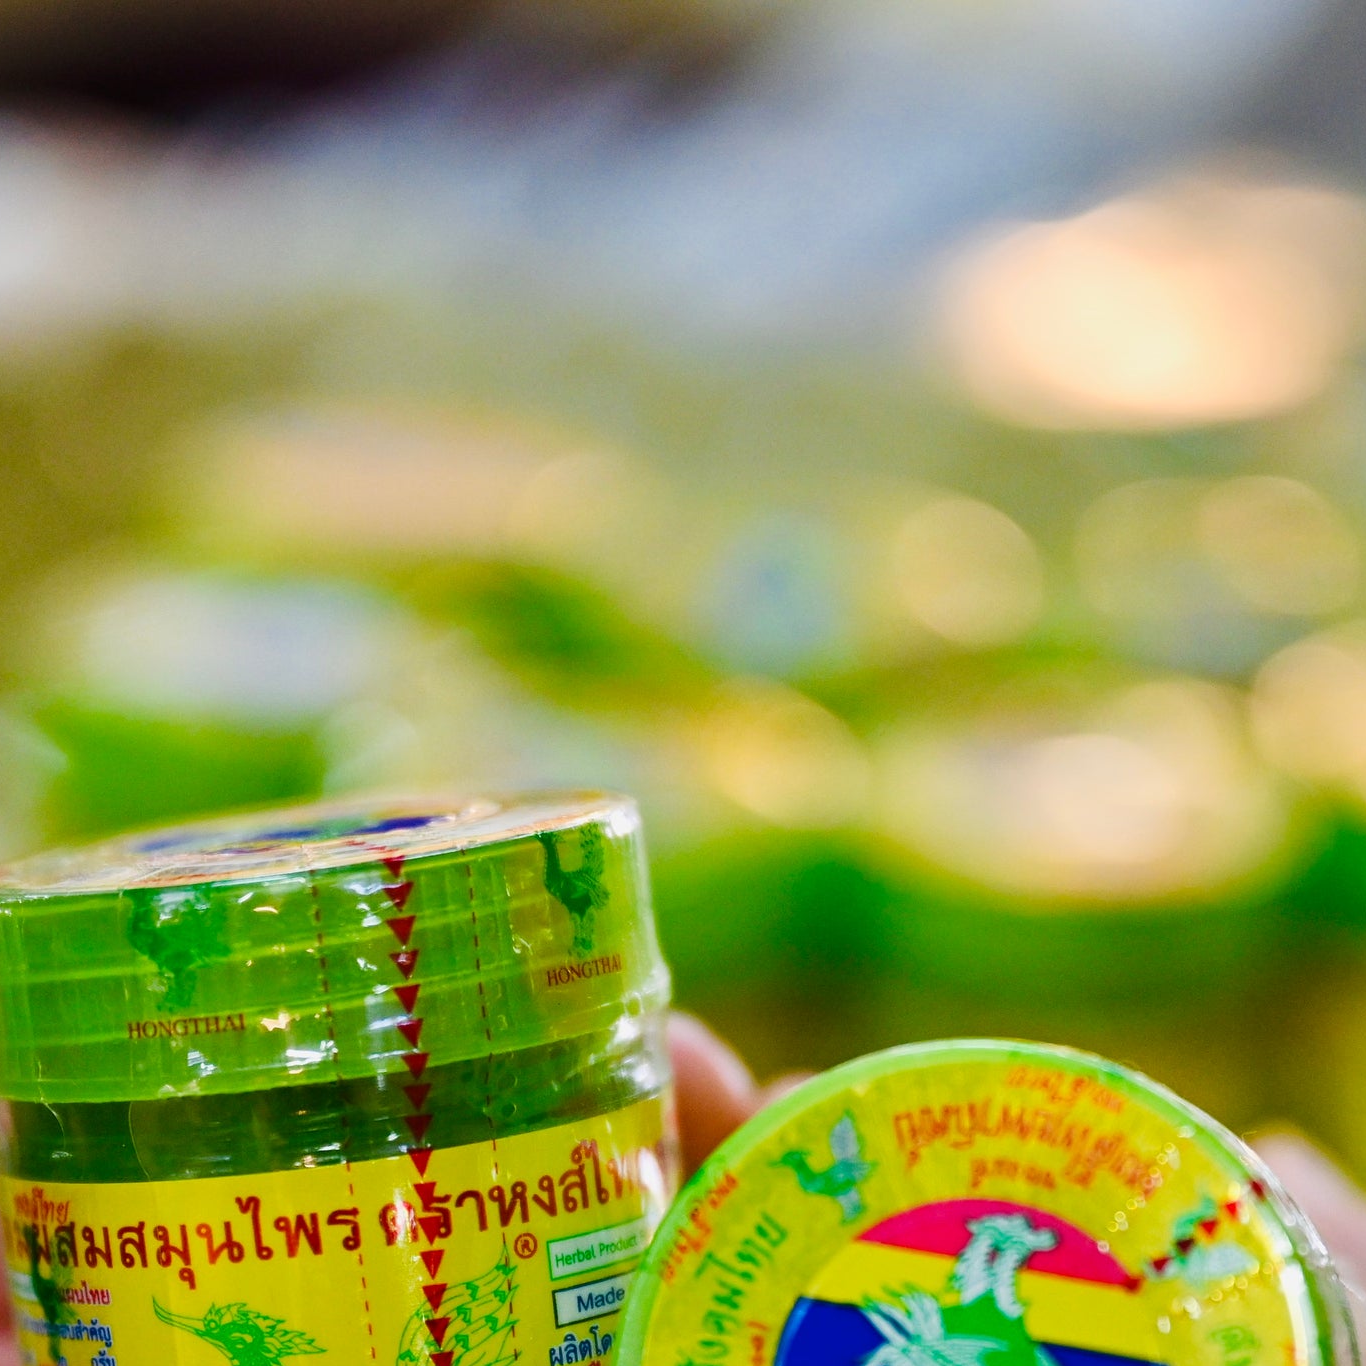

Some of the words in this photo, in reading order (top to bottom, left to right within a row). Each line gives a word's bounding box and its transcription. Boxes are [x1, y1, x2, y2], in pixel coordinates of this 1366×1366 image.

[547, 954, 622, 986] HONGTHAI
[127, 1013, 247, 1040] HONGTHAI
[7, 1195, 362, 1291] ผสมสมุนไพร
[555, 1245, 596, 1269] Herbal
[577, 1286, 625, 1313] Made
